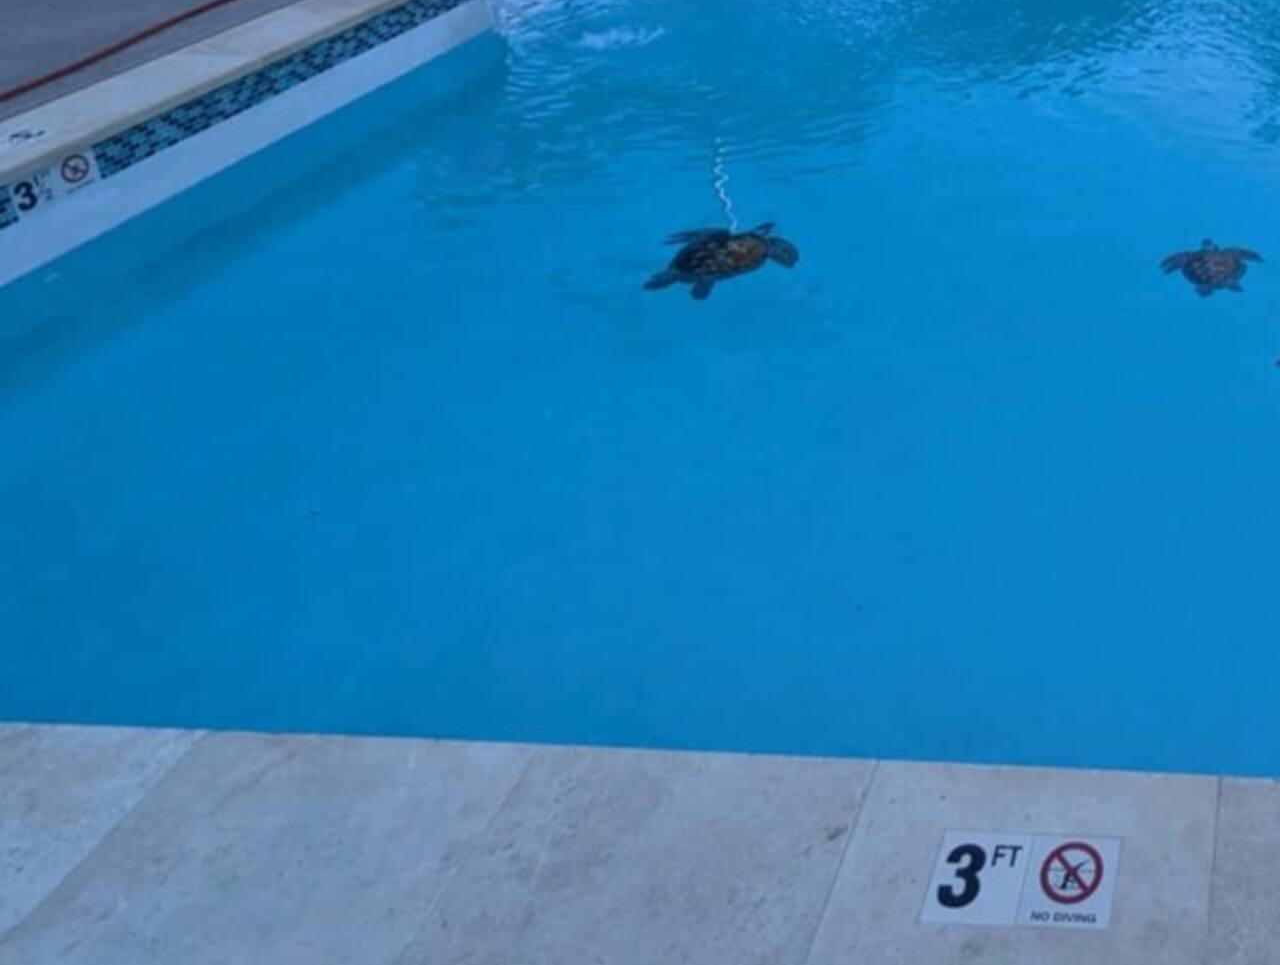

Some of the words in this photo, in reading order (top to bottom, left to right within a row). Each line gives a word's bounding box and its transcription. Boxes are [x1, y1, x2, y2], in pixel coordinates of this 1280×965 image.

[14, 181, 38, 212] 3
[937, 843, 986, 909] 3
[991, 845, 1023, 867] FT
[1030, 910, 1050, 922] NO
[1053, 911, 1097, 924] DIVING
